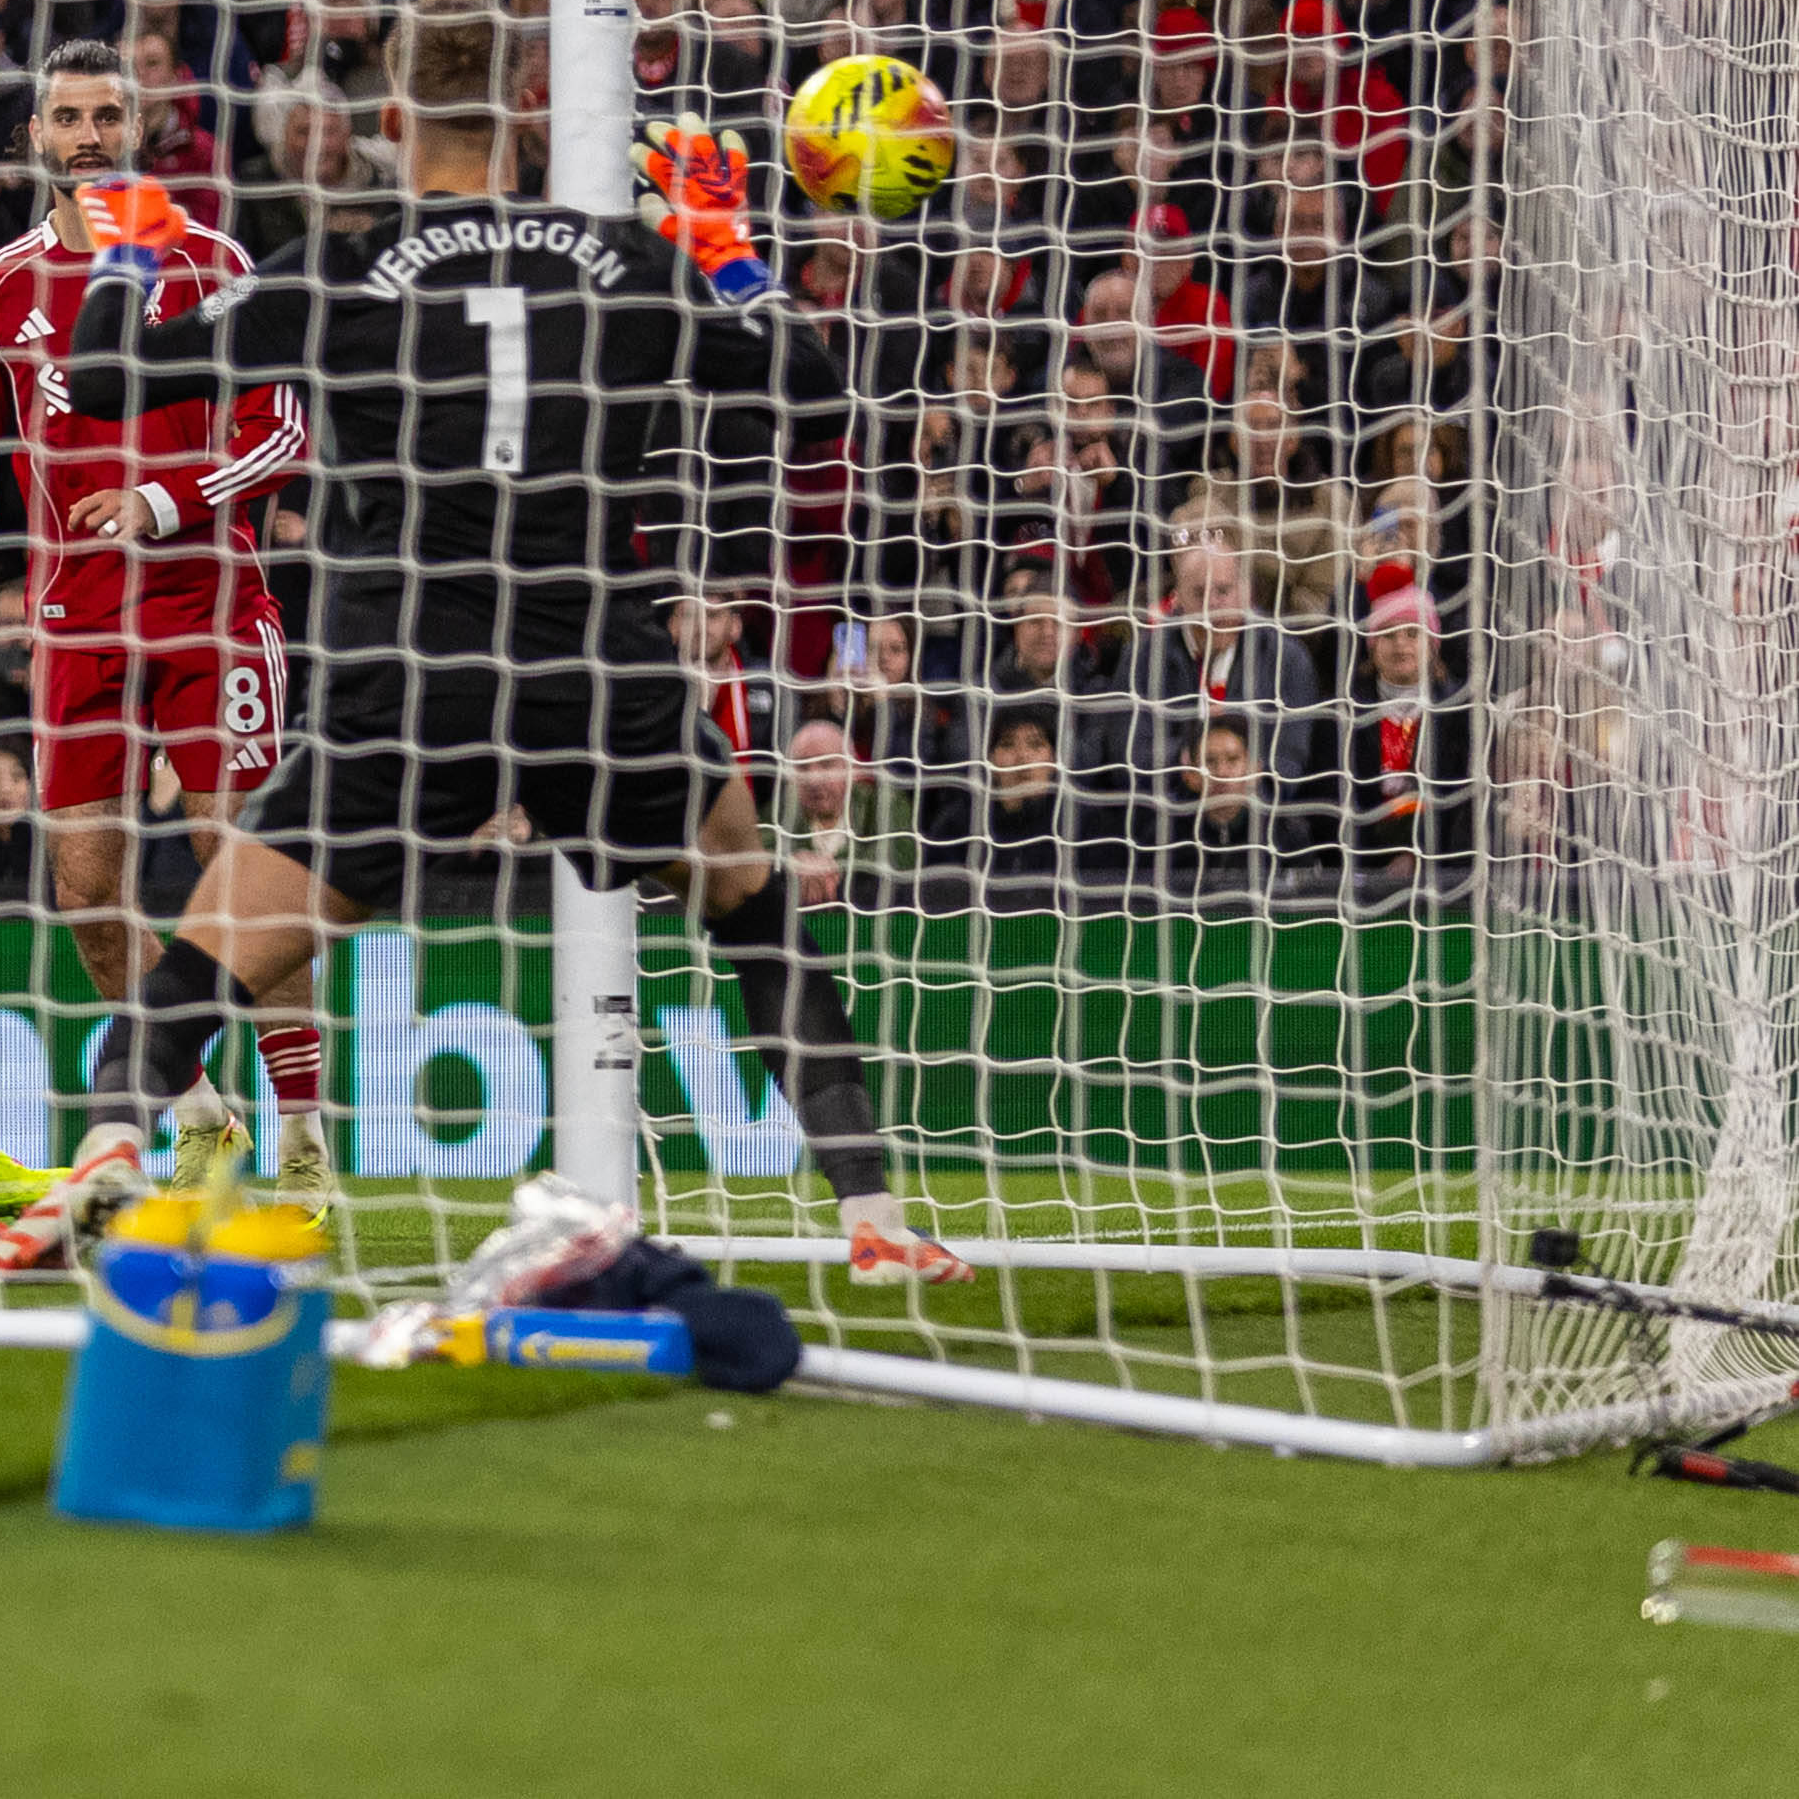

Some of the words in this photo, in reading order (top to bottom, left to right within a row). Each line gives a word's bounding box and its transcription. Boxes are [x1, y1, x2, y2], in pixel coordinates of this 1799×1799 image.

[360, 219, 627, 300] VERBRUGGEN
[464, 287, 526, 472] 1
[224, 666, 266, 732] 8
